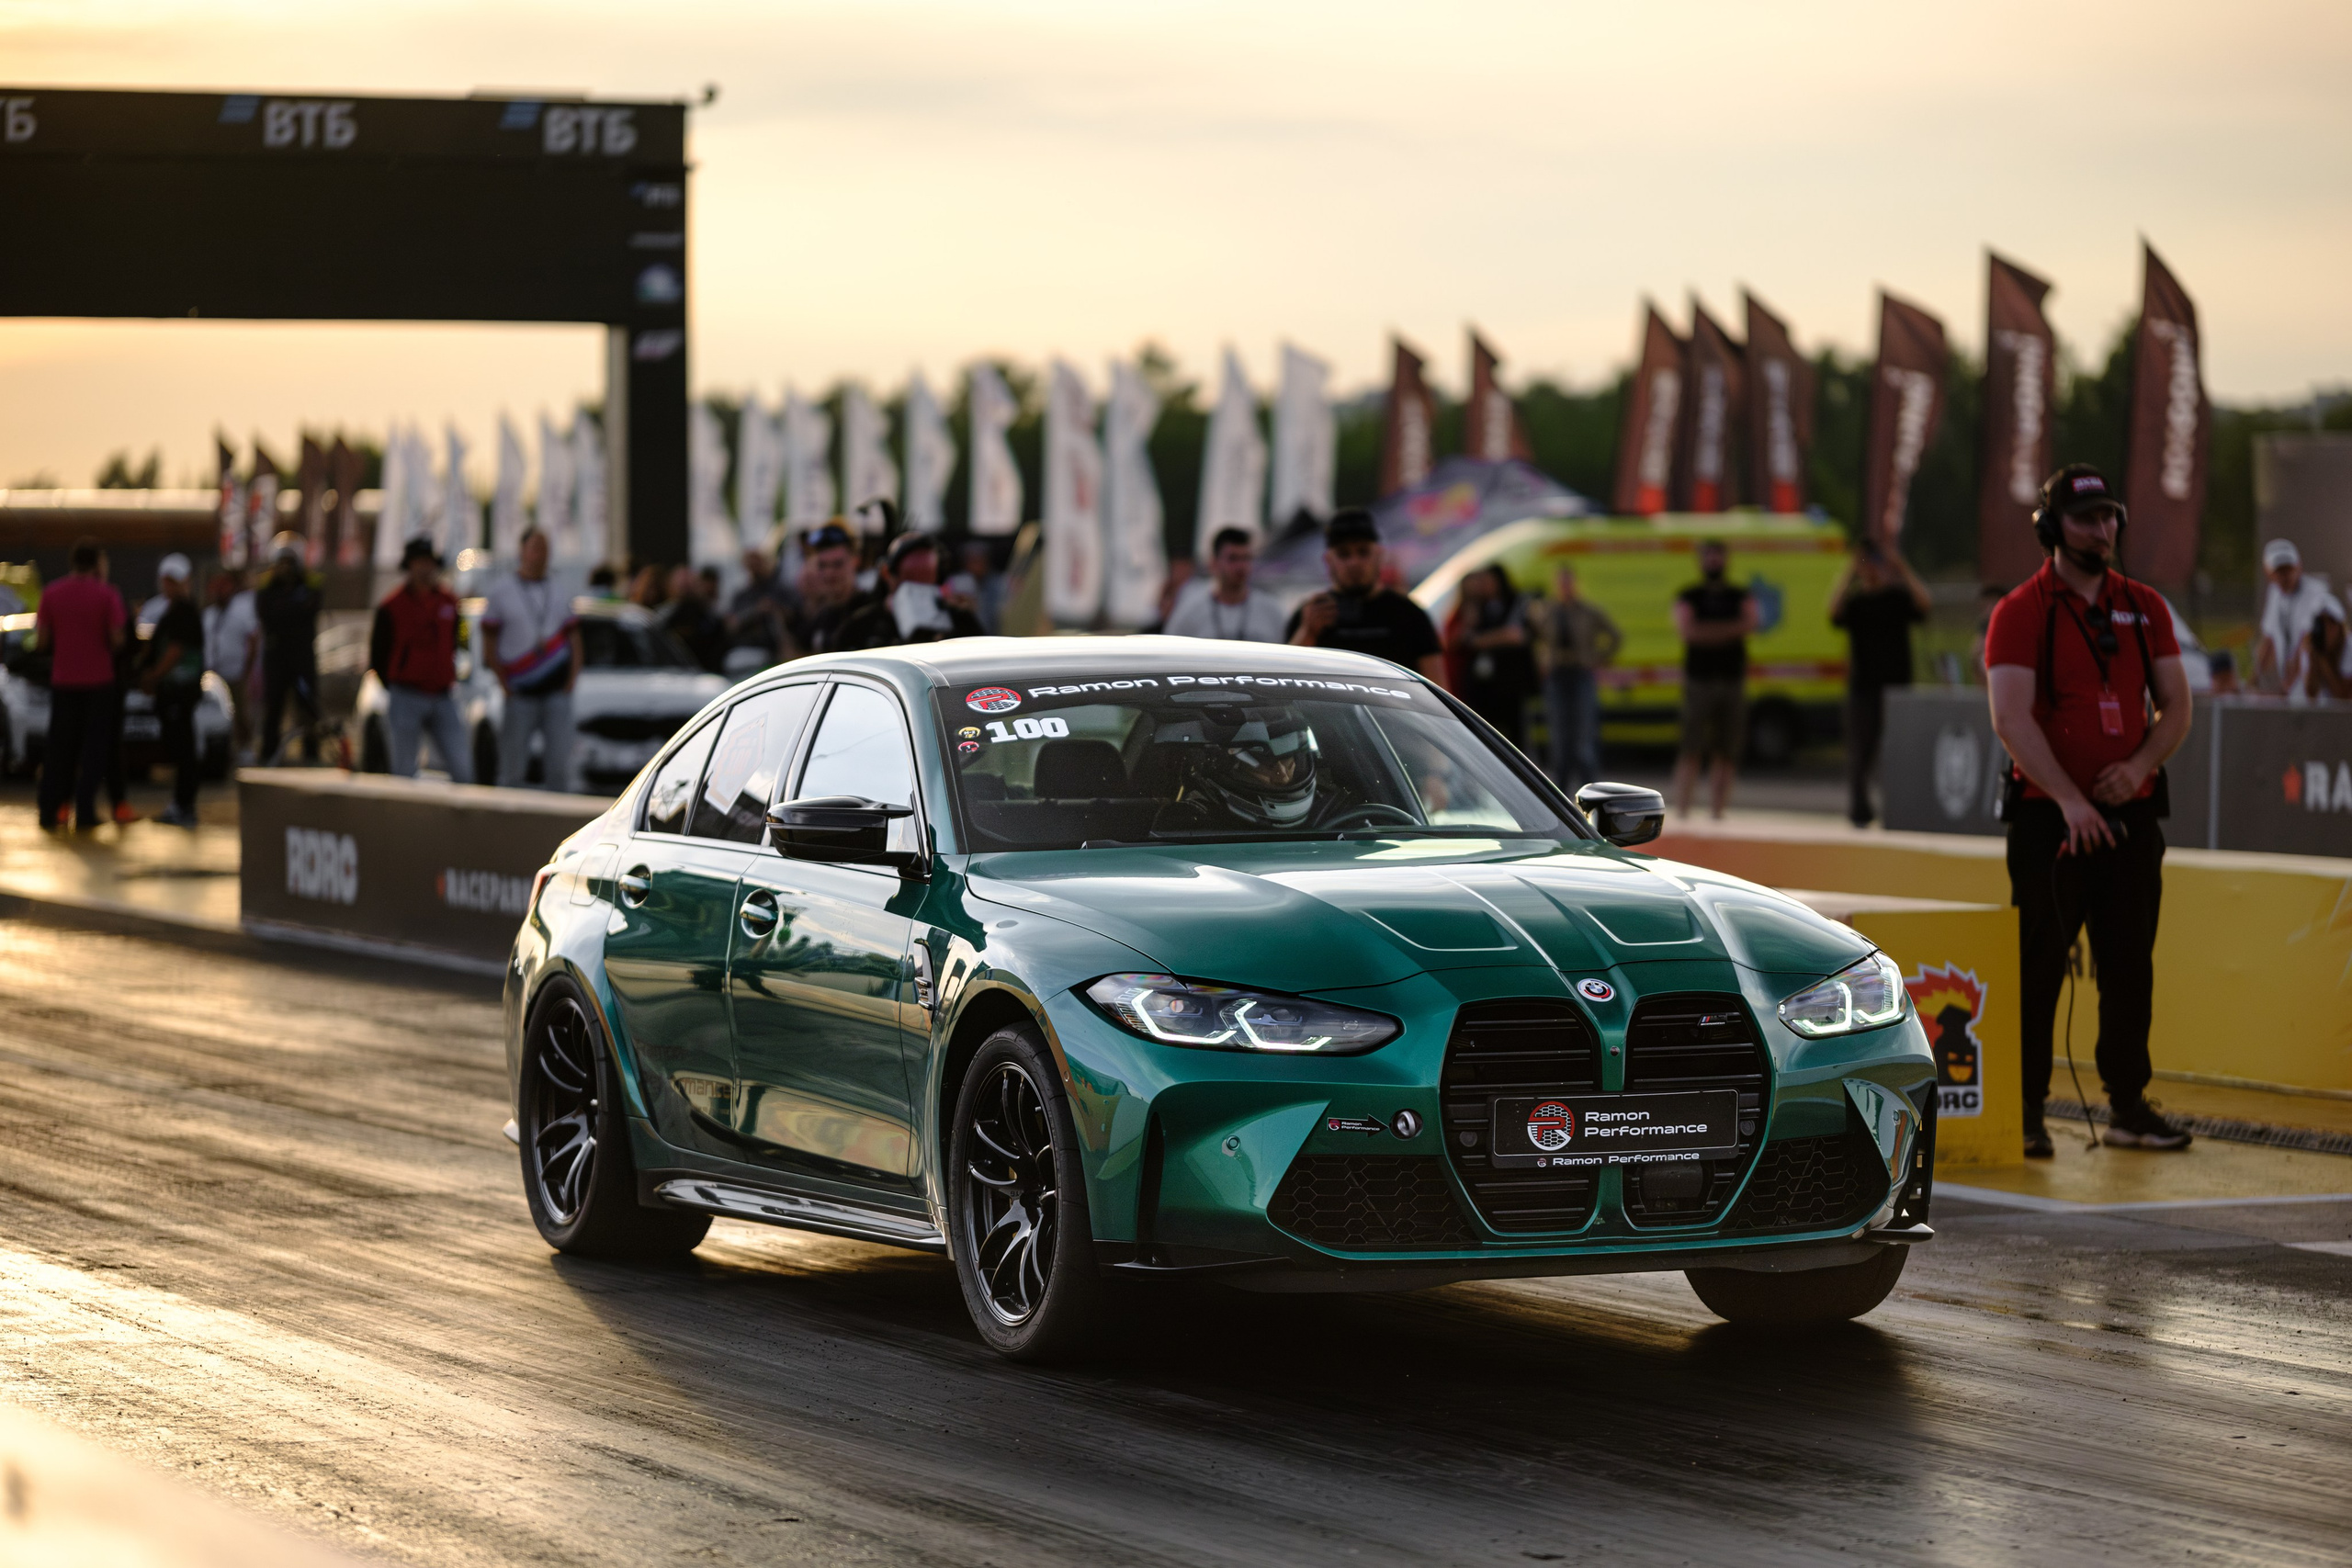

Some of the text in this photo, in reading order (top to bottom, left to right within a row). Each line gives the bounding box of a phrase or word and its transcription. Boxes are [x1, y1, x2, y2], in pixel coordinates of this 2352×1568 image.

[263, 101, 357, 150] ВТБ
[543, 107, 638, 156] ВТБ
[1027, 675, 1411, 699] Ramon Performance
[985, 716, 1069, 743] 100
[1938, 1090, 1979, 1110] RC
[1585, 1111, 1650, 1122] Ramon
[1584, 1123, 1708, 1137] Performance
[1552, 1152, 1700, 1166] Ramon Performance
